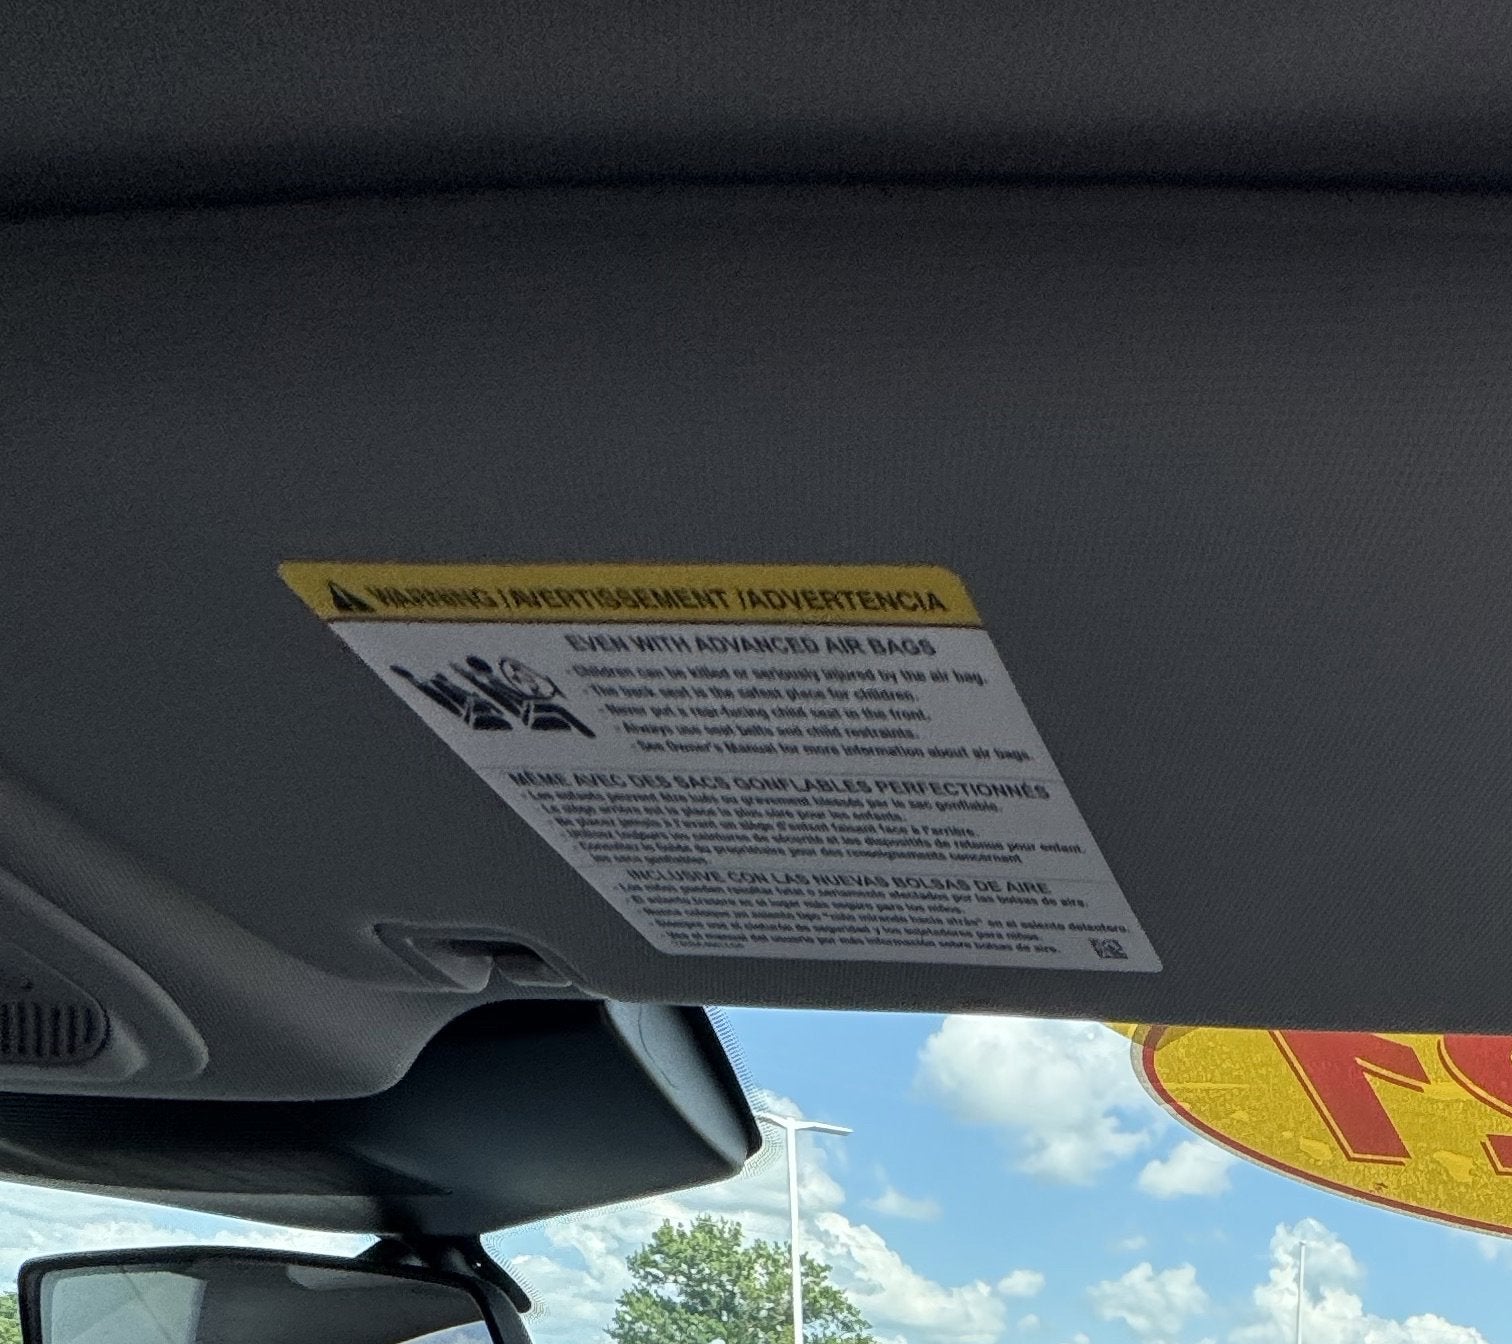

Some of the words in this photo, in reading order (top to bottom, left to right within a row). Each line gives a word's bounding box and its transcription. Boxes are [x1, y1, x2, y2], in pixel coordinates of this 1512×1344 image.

[365, 586, 499, 608] WARNING
[563, 635, 631, 652] EVEN
[628, 635, 693, 653] WITH
[690, 636, 822, 654] ADVANCED
[821, 638, 866, 655] AIR
[866, 638, 936, 656] BAGS
[625, 869, 725, 882] INCLUSIVE
[726, 872, 770, 884] CON
[770, 873, 811, 885] LAS
[811, 875, 890, 888] NUEVAS
[891, 877, 971, 891] BOLSAS
[973, 880, 1001, 892] DE
[1003, 881, 1050, 893] AIRE
